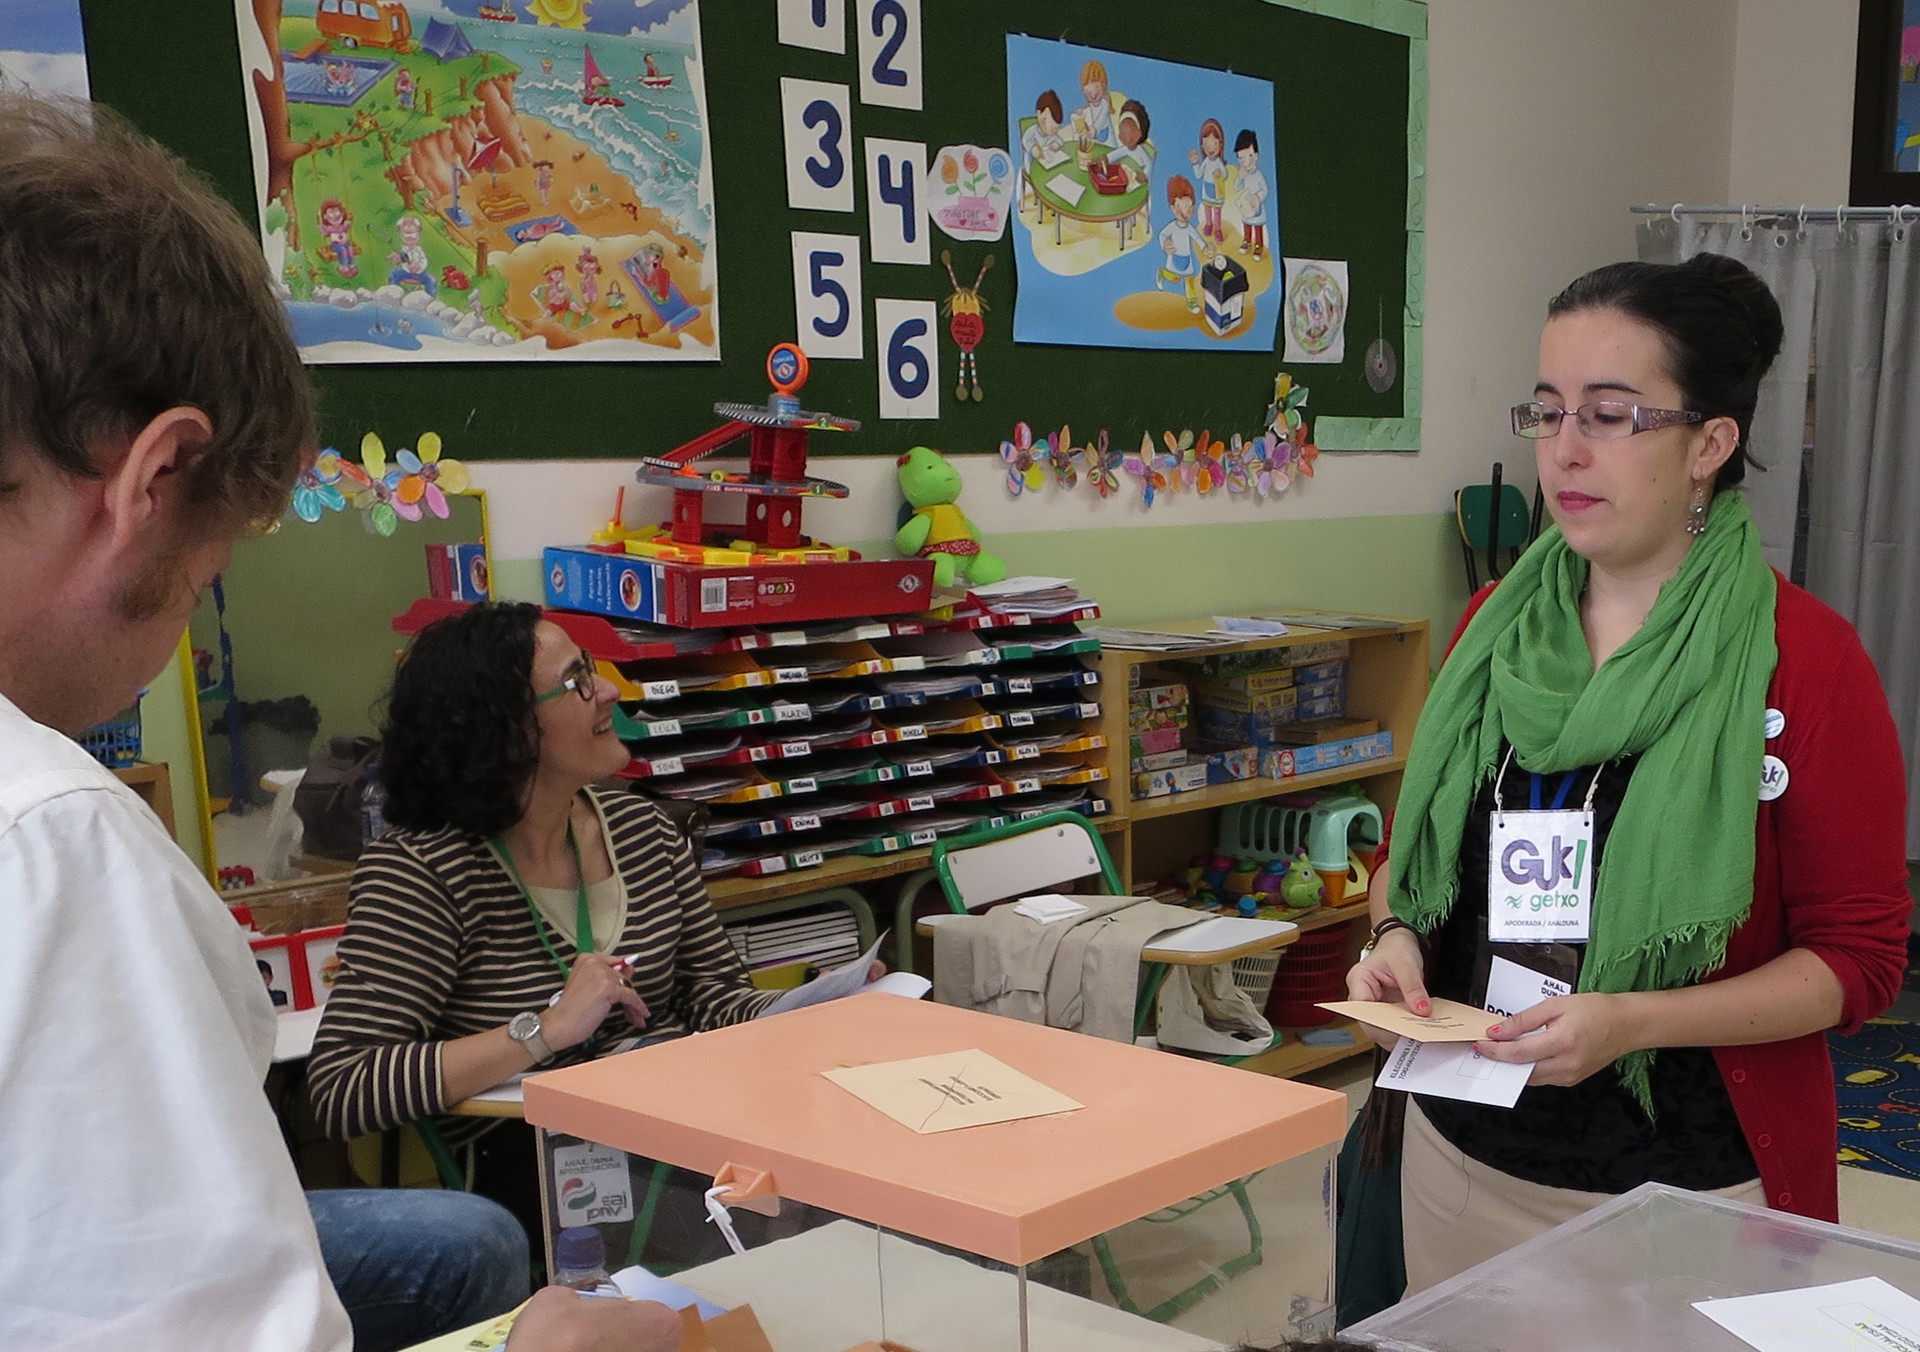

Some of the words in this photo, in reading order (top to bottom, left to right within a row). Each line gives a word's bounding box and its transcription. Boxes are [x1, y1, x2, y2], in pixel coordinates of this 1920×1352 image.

[871, 0, 908, 87] 2
[802, 99, 844, 189] 3
[877, 153, 916, 244] 4
[809, 250, 850, 338] 5
[887, 317, 930, 400] 6
[1504, 919, 1542, 927] APODERADA
[1529, 890, 1580, 913] getxo
